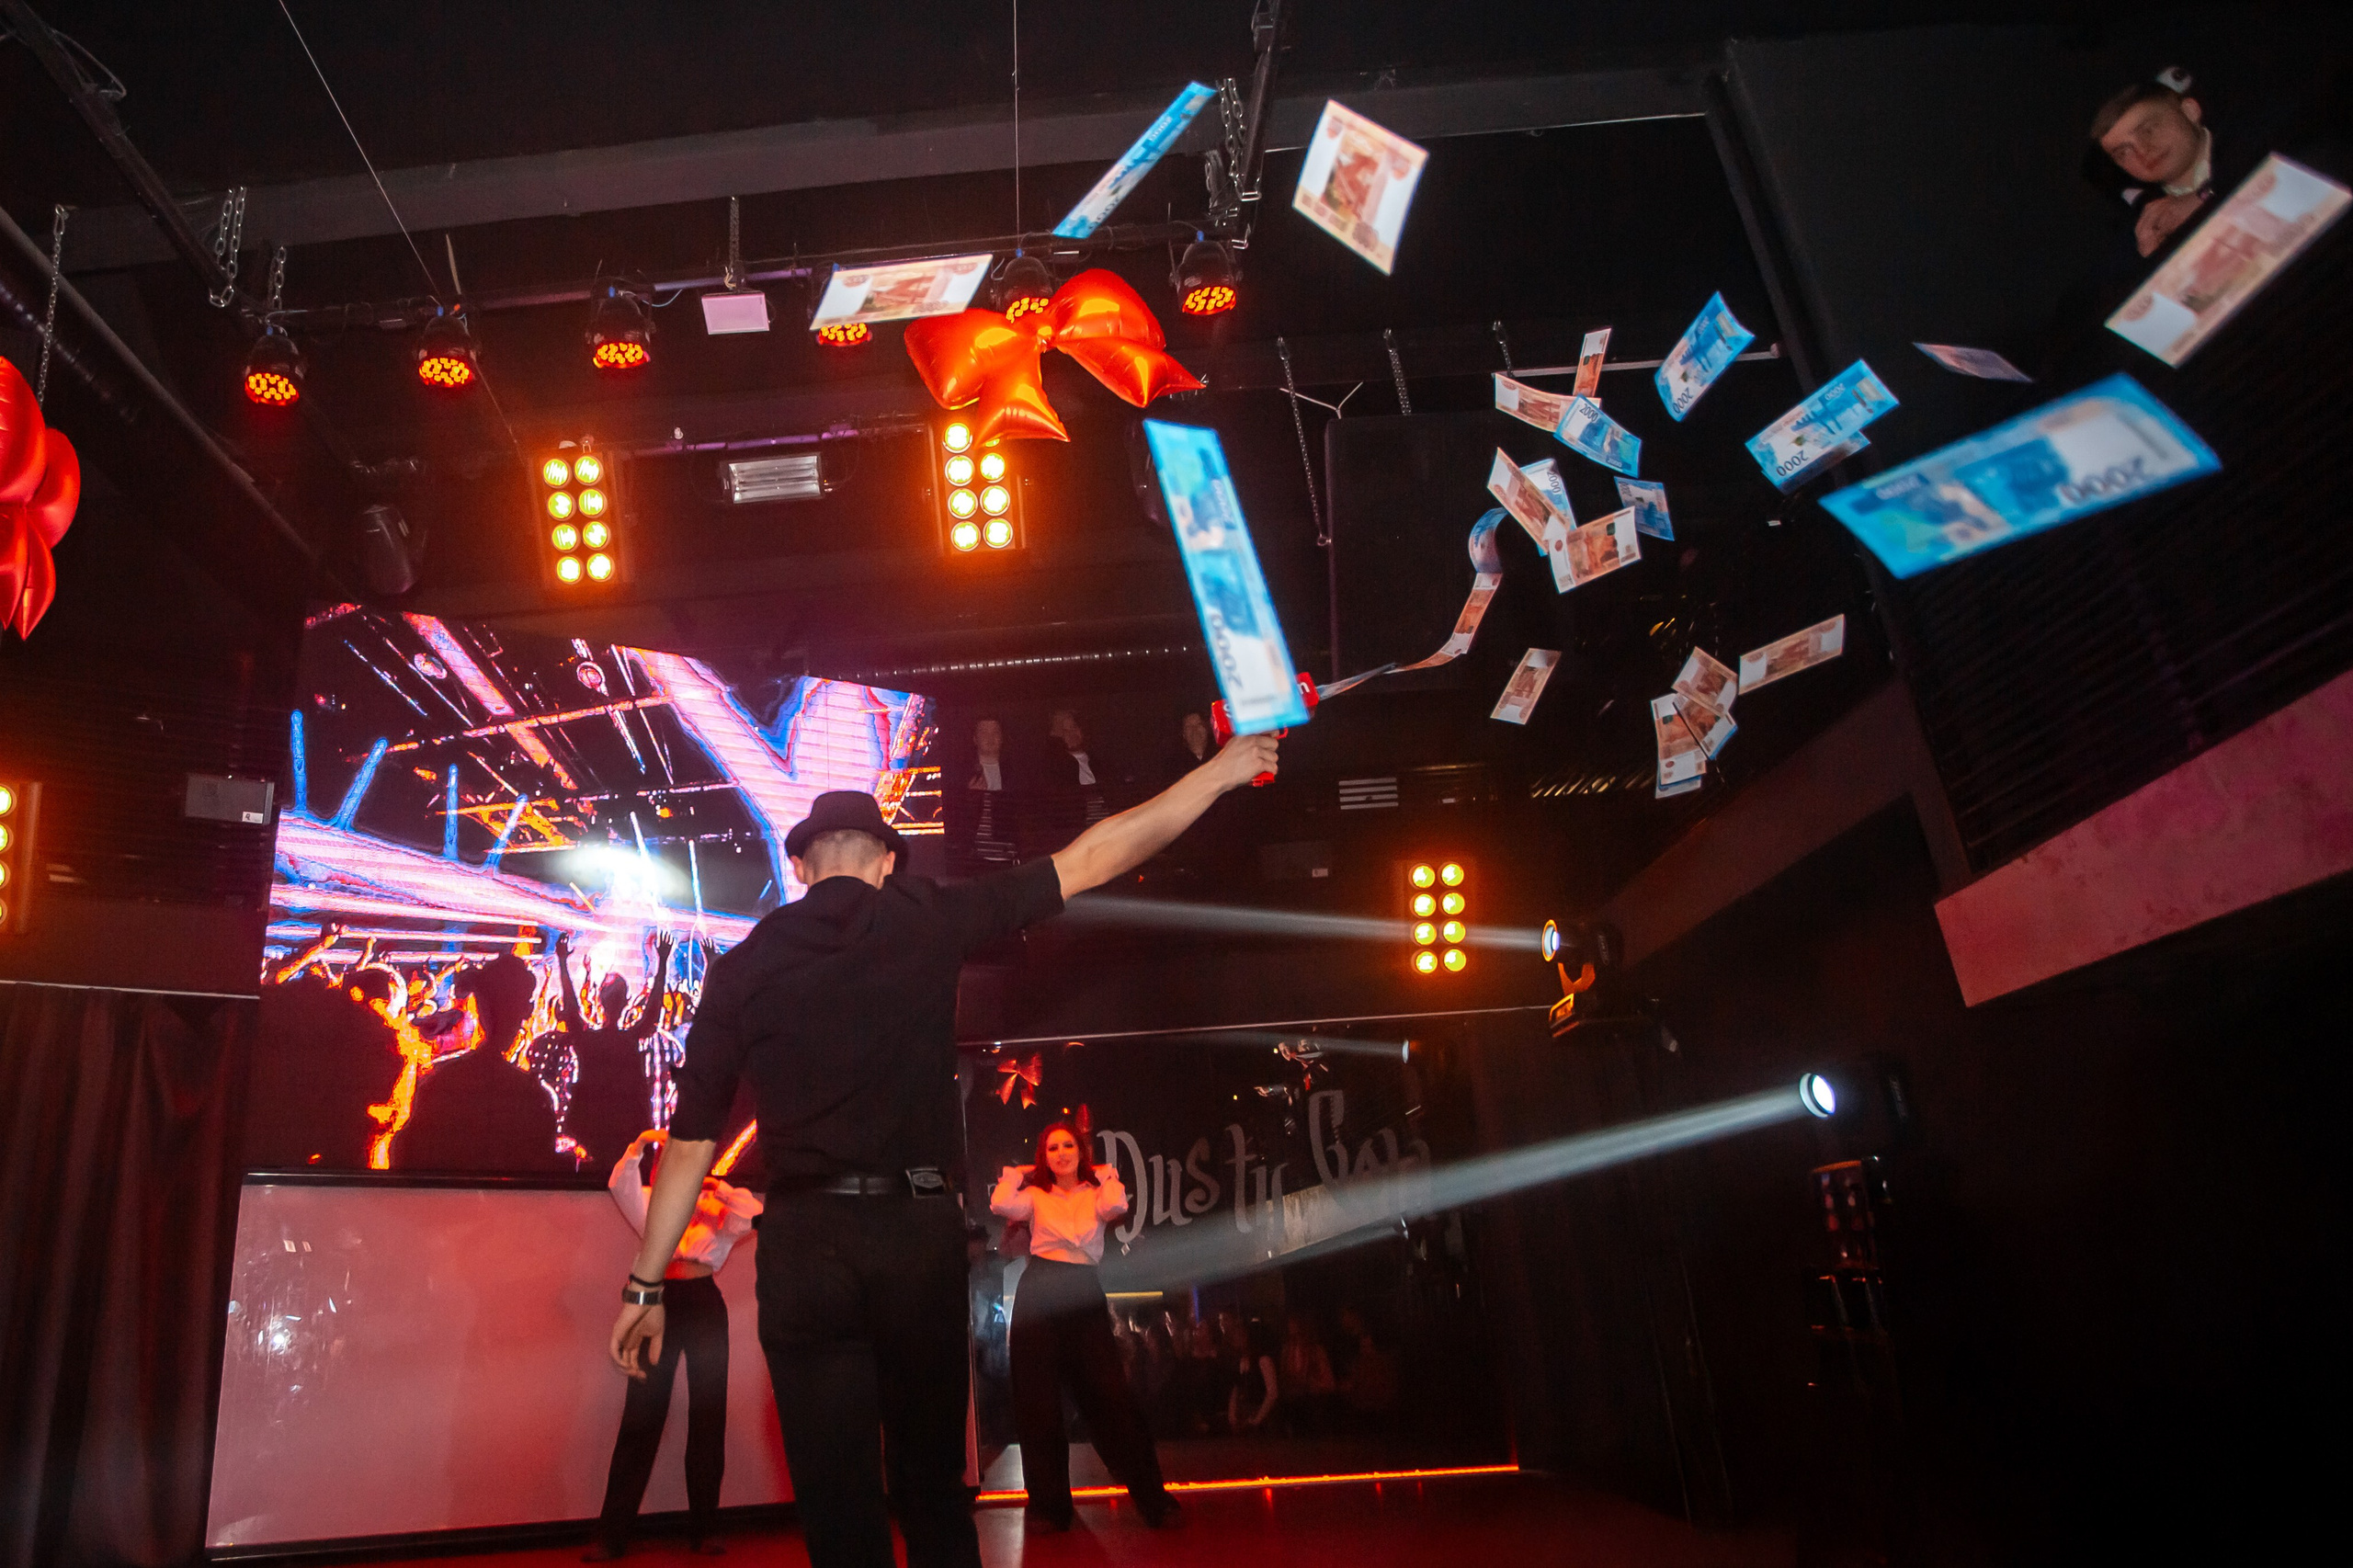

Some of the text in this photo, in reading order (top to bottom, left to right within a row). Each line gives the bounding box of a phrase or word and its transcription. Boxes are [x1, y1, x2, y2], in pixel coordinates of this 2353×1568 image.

[1579, 403, 1598, 423] 2000
[1672, 387, 1693, 414] 2000
[1776, 449, 1809, 477] 2000
[1546, 470, 1561, 494] 2000
[1097, 1123, 1289, 1252] Dusty
